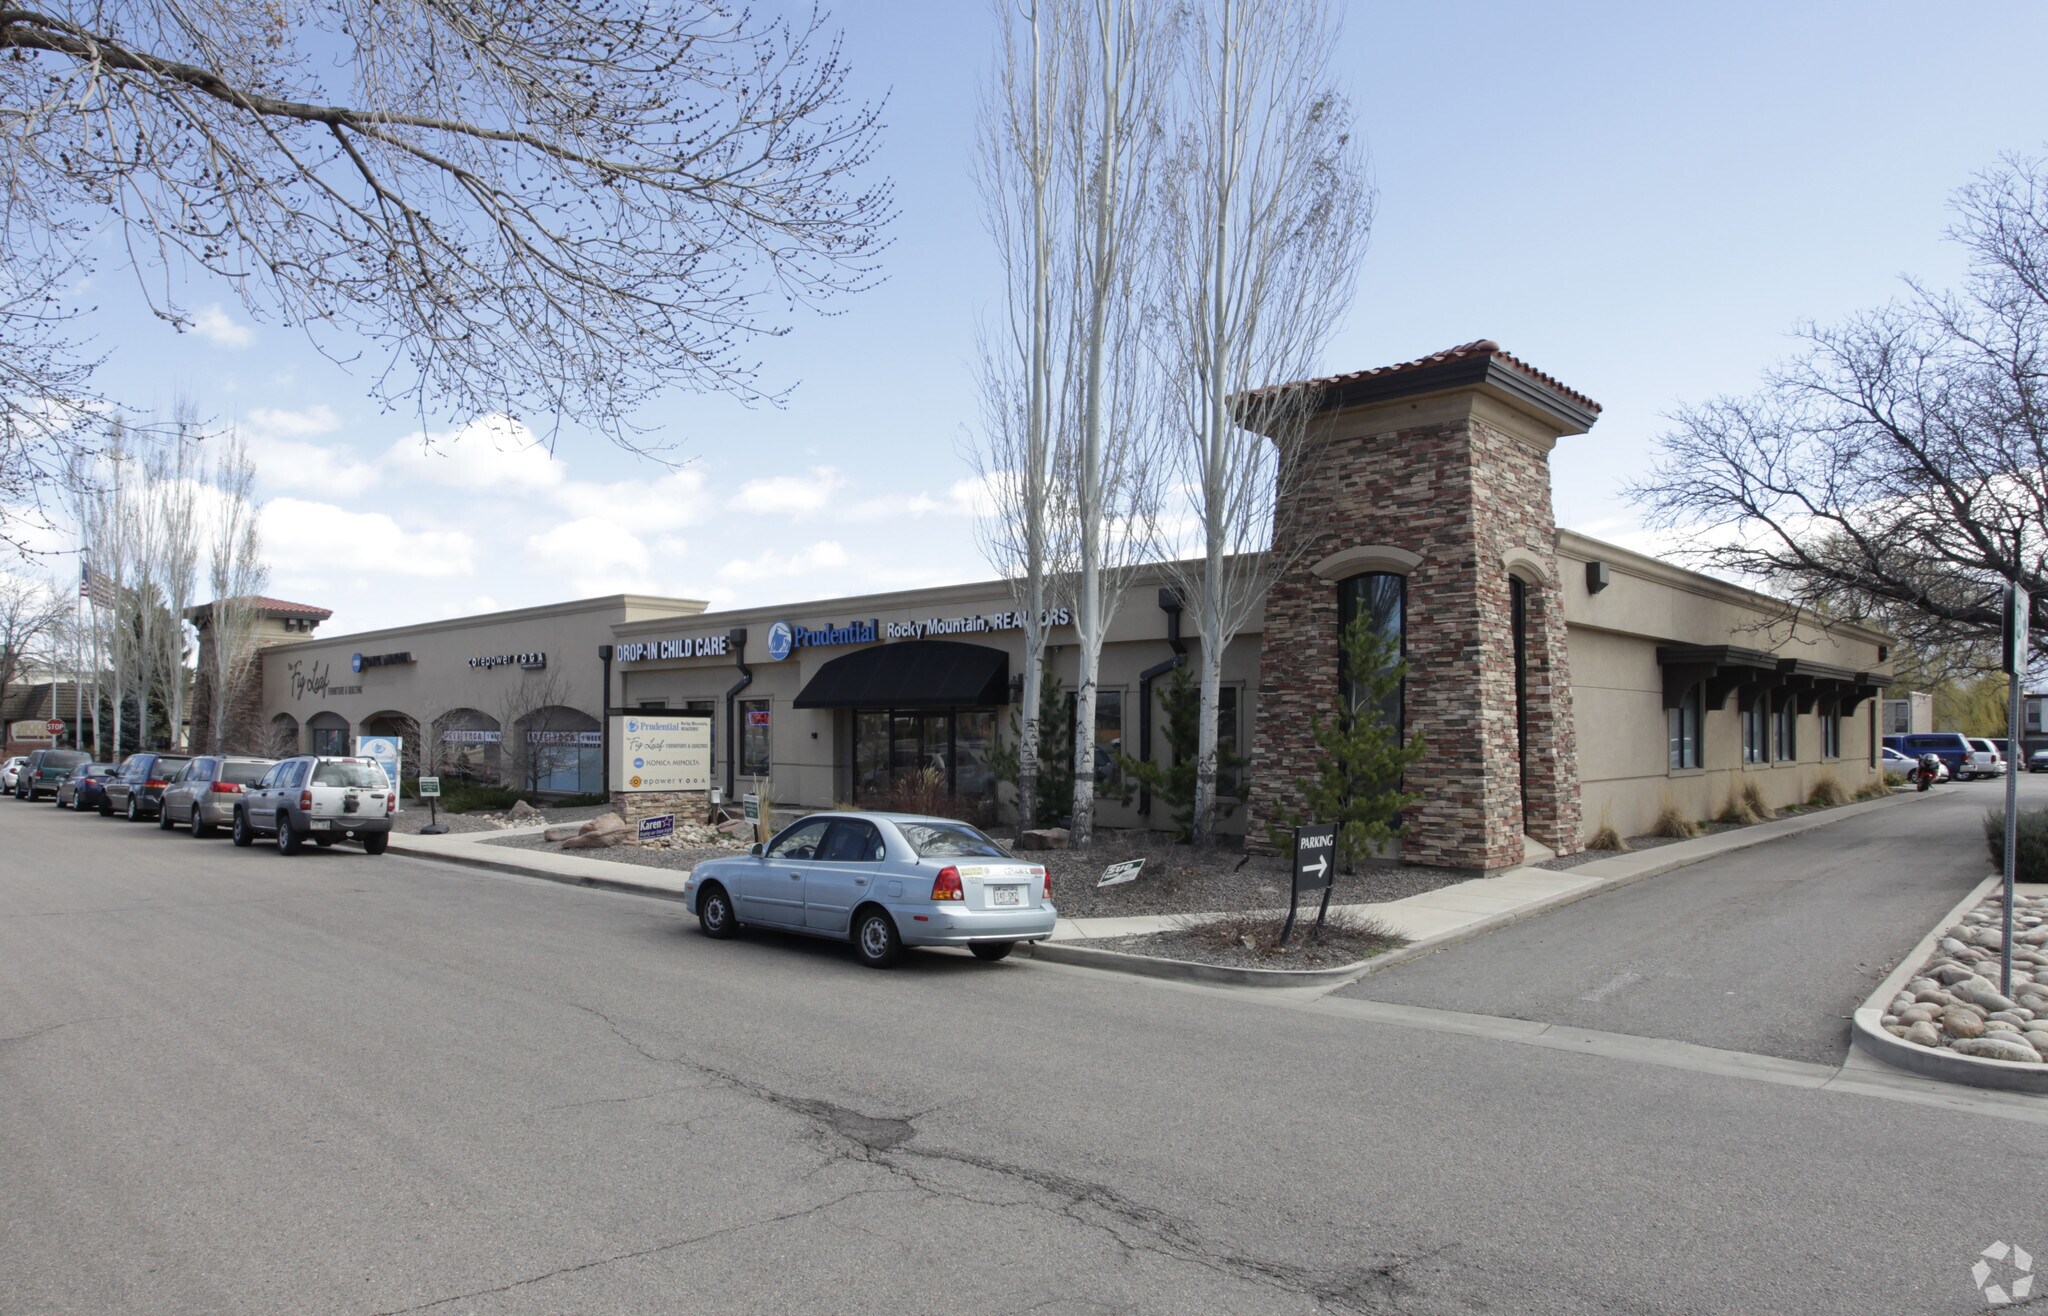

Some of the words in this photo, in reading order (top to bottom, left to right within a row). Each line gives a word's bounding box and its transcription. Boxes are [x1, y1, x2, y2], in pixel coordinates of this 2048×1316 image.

[887, 621, 923, 639] Rocky
[926, 617, 990, 636] Mountain,
[994, 607, 1069, 630] REALORS
[793, 619, 876, 647] Prudential
[617, 642, 658, 662] DROP-IN
[661, 639, 692, 659] CHILD
[695, 635, 726, 656] CARE
[291, 660, 306, 701] Fig
[306, 660, 330, 699] Leaf
[640, 721, 679, 731] Prudential
[464, 732, 482, 740] YOGA
[630, 737, 642, 751] Fig
[644, 738, 664, 751] Leaf
[629, 777, 675, 786] corepower
[640, 820, 662, 831] Karen
[1300, 834, 1334, 850] PARKING
